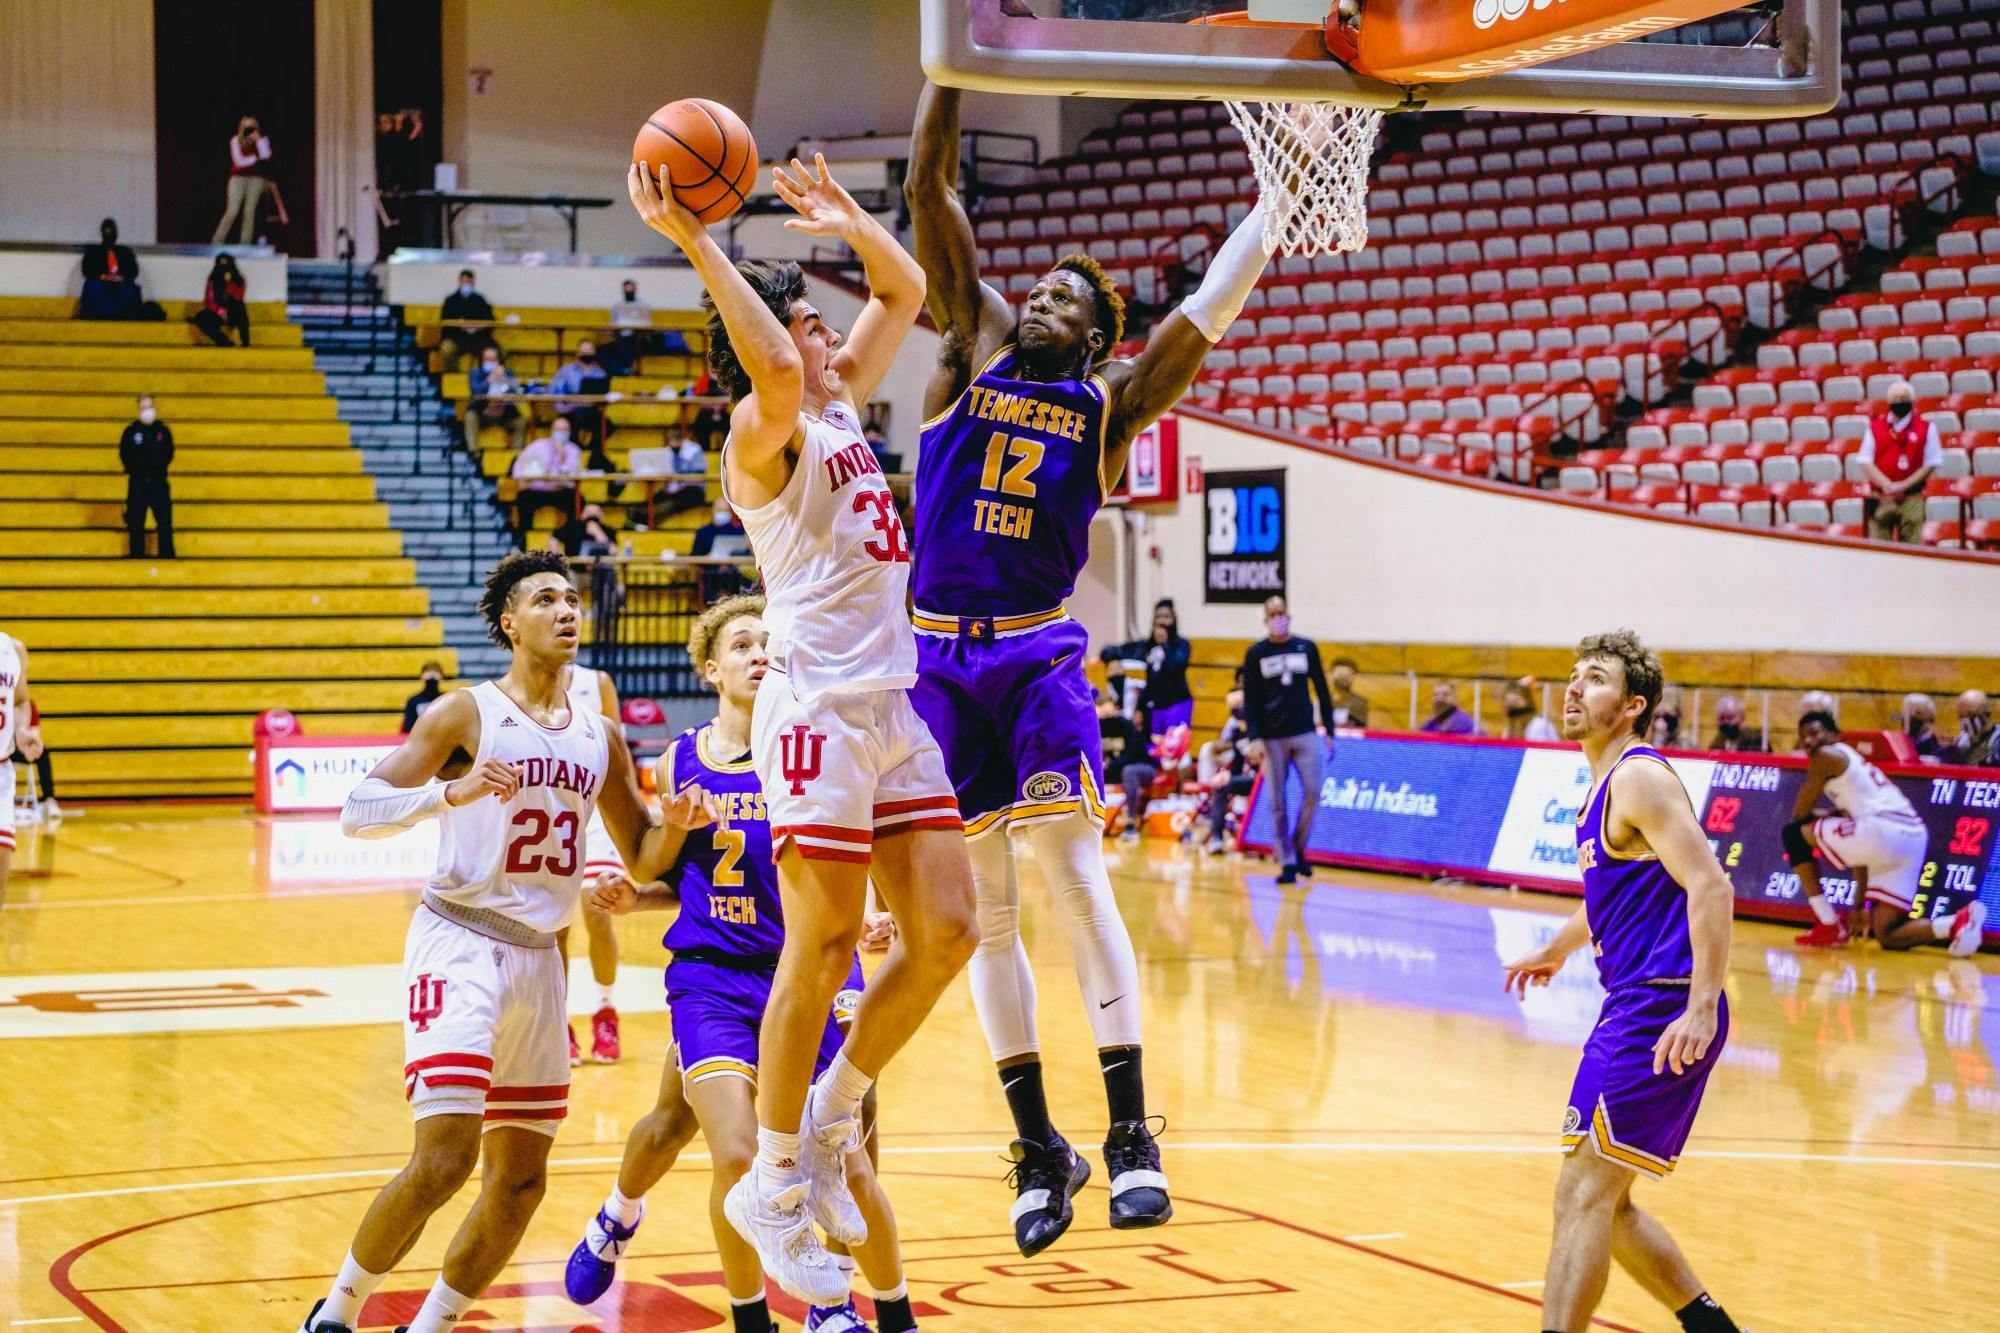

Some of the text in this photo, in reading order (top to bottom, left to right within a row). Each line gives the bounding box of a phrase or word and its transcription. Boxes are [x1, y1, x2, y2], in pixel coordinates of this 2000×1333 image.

[968, 385, 1087, 443] TENNESSEE
[980, 431, 1046, 498] 12
[853, 490, 911, 563] 32
[973, 499, 1034, 539] TECH
[494, 757, 597, 801] NDIANA
[1711, 763, 1782, 793] INDIANA
[1930, 778, 1957, 805] TN
[1705, 796, 1742, 833] 62
[506, 808, 579, 877] 23
[712, 829, 747, 887] 2
[1725, 842, 1743, 867] 2
[1765, 871, 1801, 899] 2ND
[1919, 861, 1978, 892] 2 TOL
[707, 893, 757, 925] TECH
[1909, 894, 1929, 920] 5
